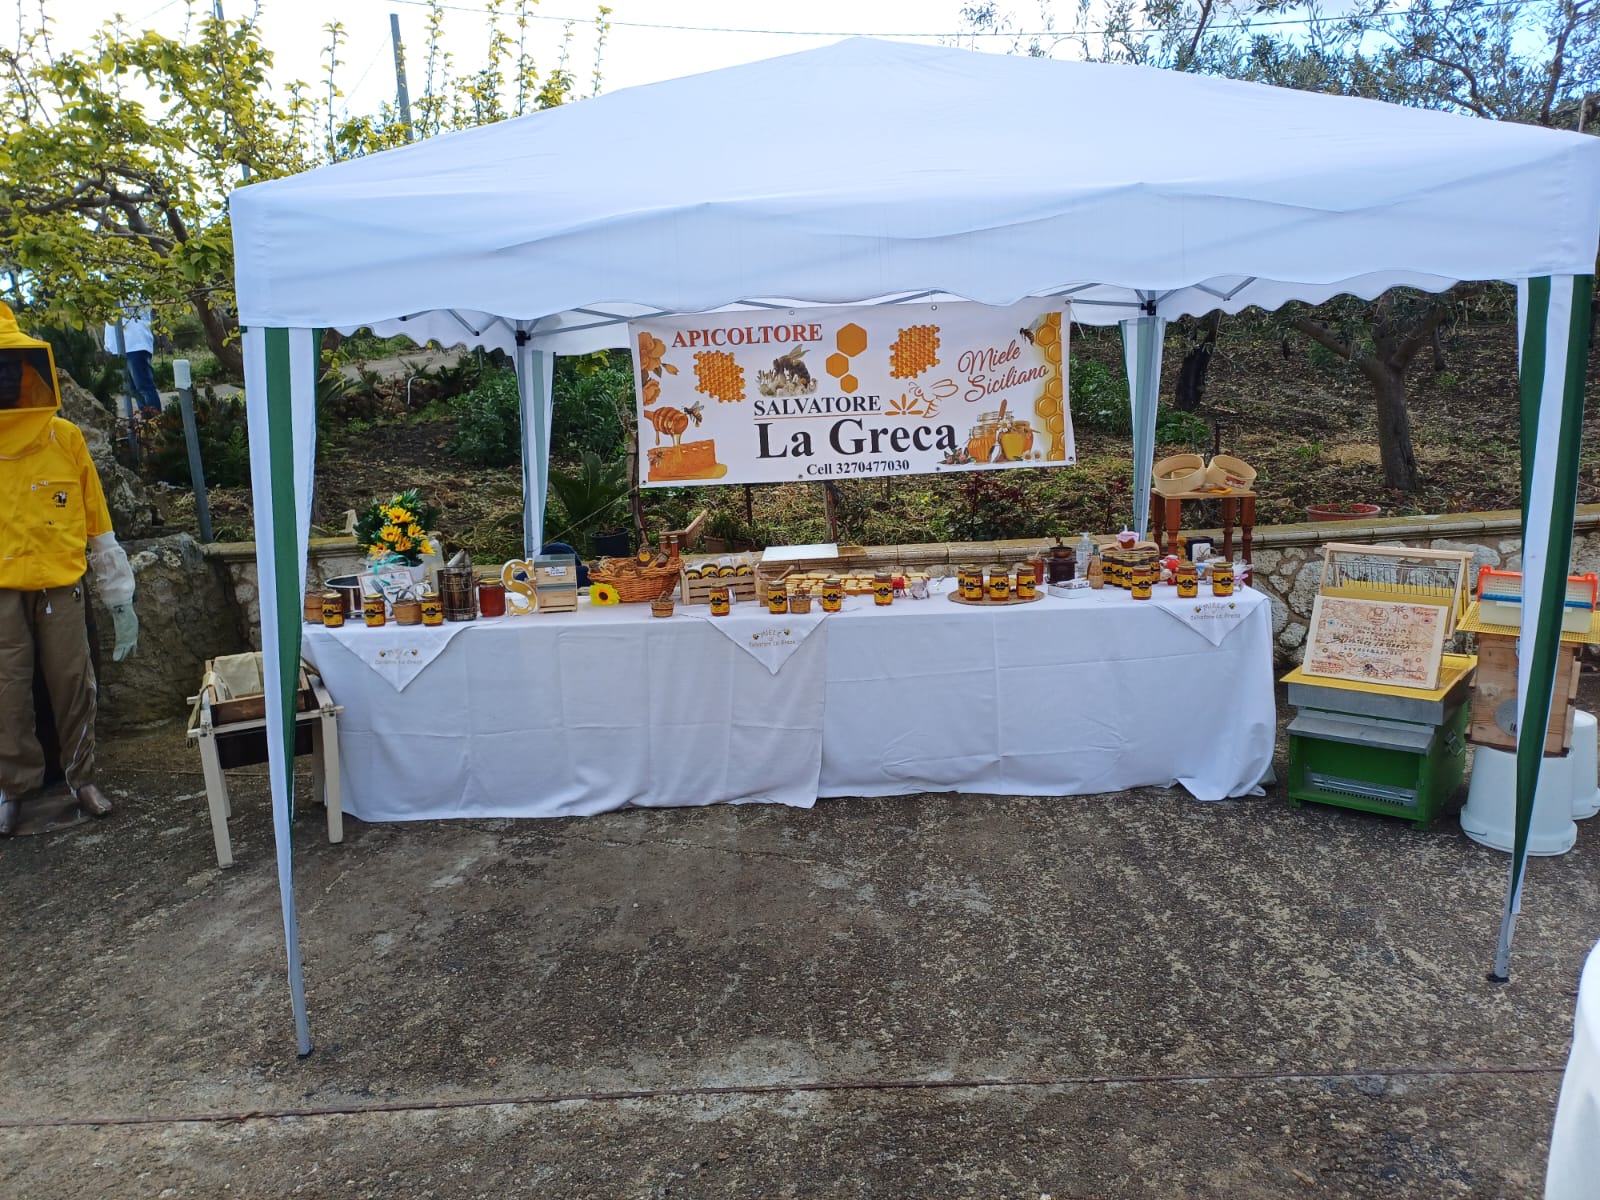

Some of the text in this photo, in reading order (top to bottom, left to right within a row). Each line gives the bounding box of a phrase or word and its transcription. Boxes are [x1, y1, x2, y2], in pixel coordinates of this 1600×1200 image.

[671, 323, 824, 348] APICOLTORE
[957, 338, 1021, 375] Miele
[964, 364, 1050, 402] Siciliano
[753, 395, 881, 417] SALVATORE
[754, 417, 959, 459] La Greca
[806, 459, 910, 476] Cell 3270477030
[501, 558, 538, 617] S
